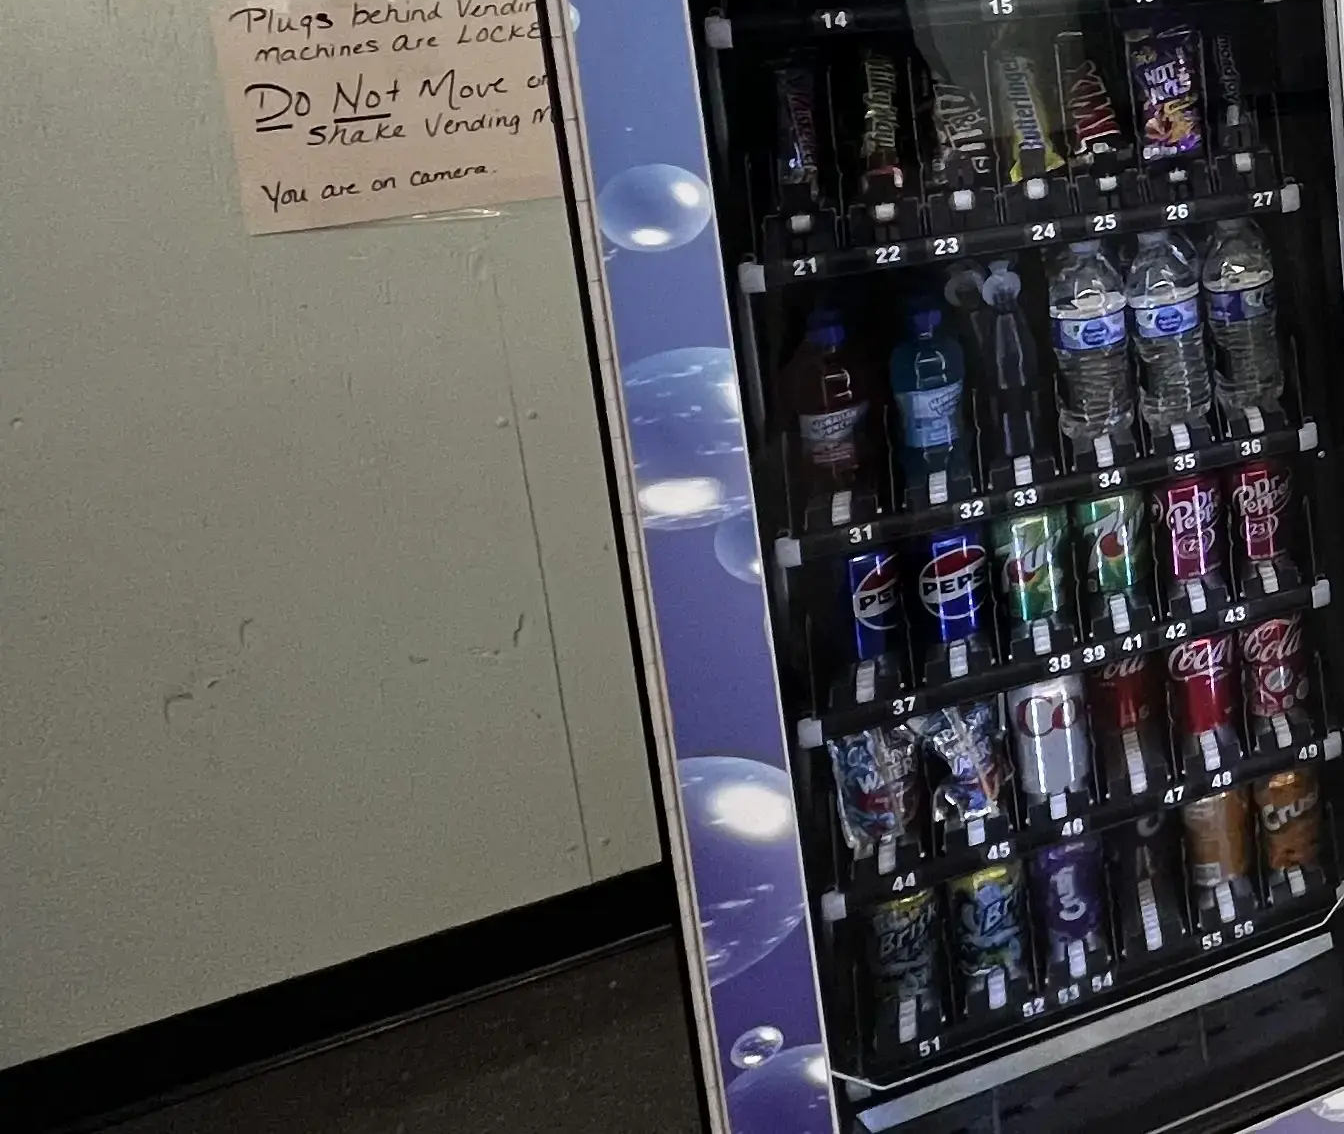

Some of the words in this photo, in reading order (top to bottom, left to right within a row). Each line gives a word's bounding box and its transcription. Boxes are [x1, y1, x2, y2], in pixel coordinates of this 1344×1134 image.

[229, 7, 333, 40] Plugs
[352, 0, 441, 29] behind
[821, 11, 847, 29] 14
[989, 0, 1013, 16] 15
[255, 40, 379, 63] machines
[457, 21, 541, 44] LOCKE
[332, 73, 399, 115] Not
[419, 69, 508, 111] Move
[424, 112, 521, 138] Vending
[261, 181, 308, 213] You
[321, 181, 361, 200] are
[372, 175, 396, 192] on
[792, 257, 818, 276] 21
[875, 245, 901, 265] 22
[933, 237, 960, 256] 23
[1031, 223, 1056, 241] 24
[1093, 214, 1117, 232] 25
[1165, 204, 1189, 221] 26
[1252, 191, 1274, 208] 27
[849, 524, 873, 543] 31
[959, 500, 984, 519] 32
[1013, 488, 1038, 507] 33
[1098, 470, 1122, 488] 34
[1173, 455, 1196, 471] 35
[1240, 439, 1262, 456] 36
[1254, 475, 1280, 497] Dr
[1250, 523, 1266, 536] 23
[892, 696, 916, 715] 37
[1048, 654, 1072, 673] 38
[1083, 645, 1106, 663] 39
[1122, 633, 1142, 652] 41
[1165, 622, 1188, 640] 42
[1224, 606, 1246, 623] 43
[1163, 785, 1185, 804] 47
[1212, 770, 1233, 788] 48
[919, 1035, 941, 1057] 51
[1201, 932, 1223, 950] 55
[1234, 921, 1255, 938] 56
